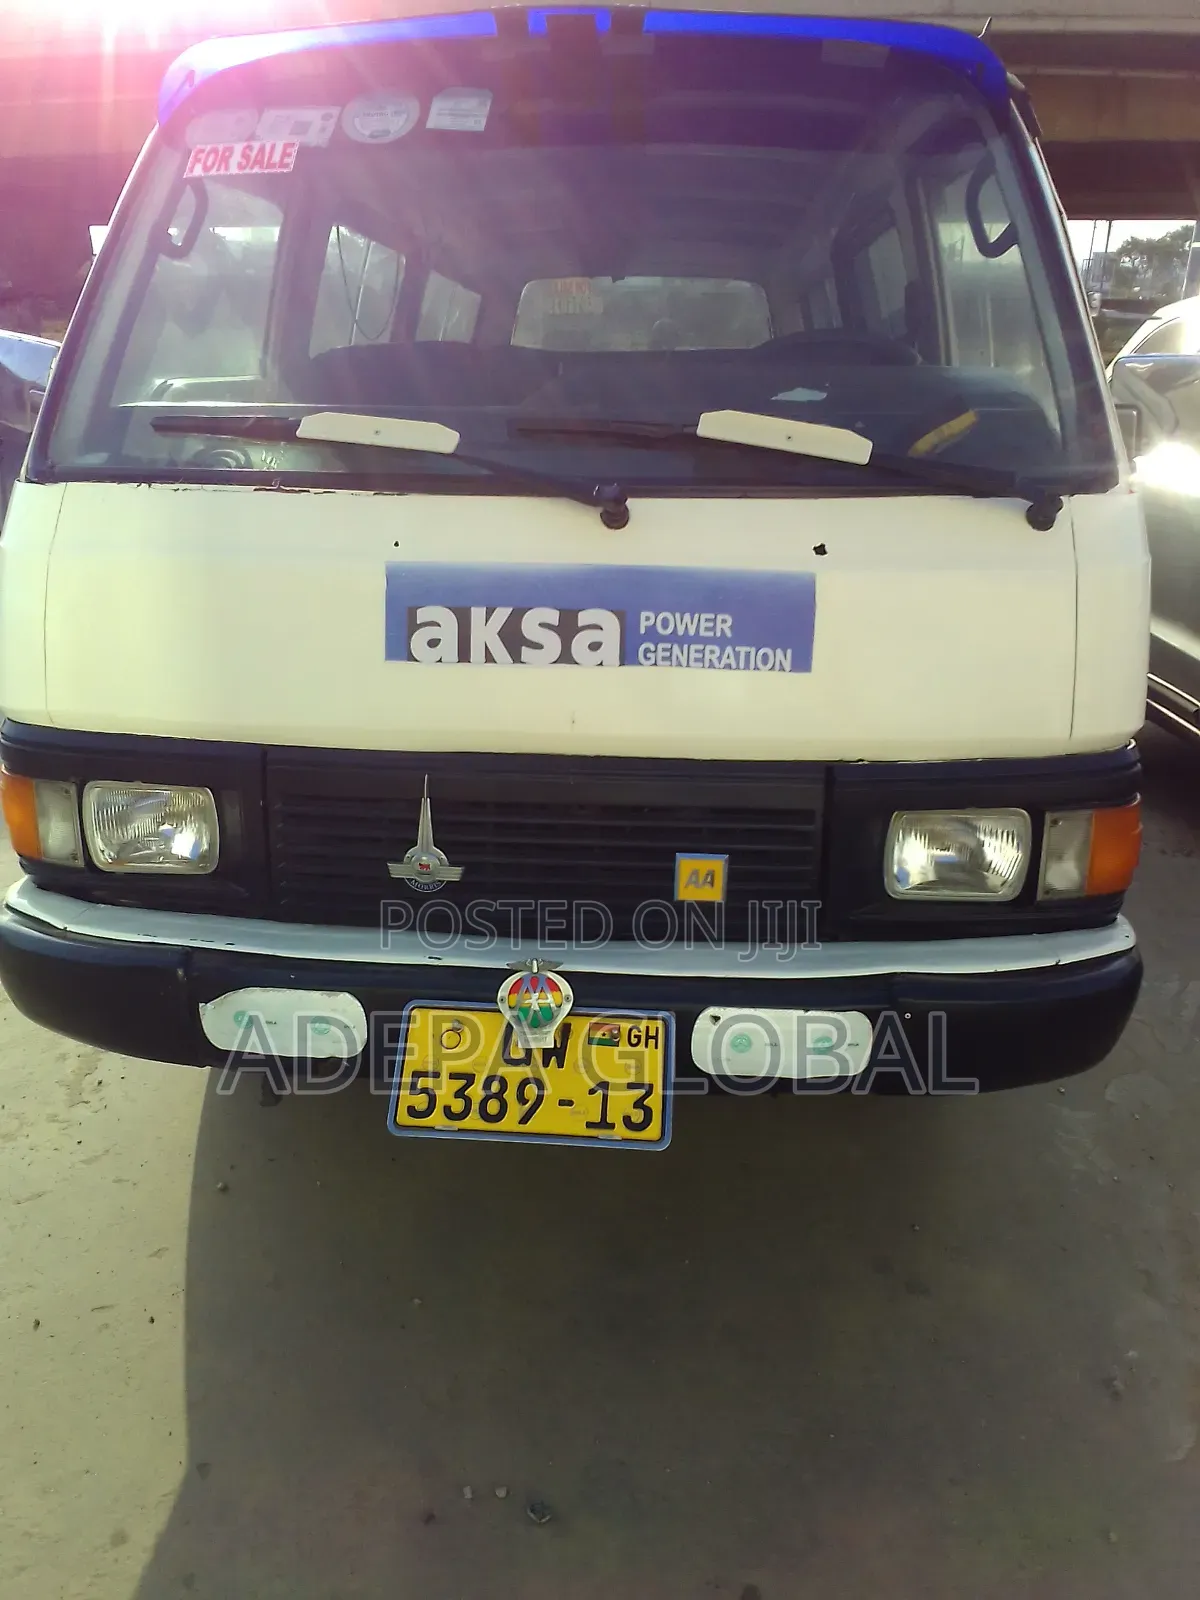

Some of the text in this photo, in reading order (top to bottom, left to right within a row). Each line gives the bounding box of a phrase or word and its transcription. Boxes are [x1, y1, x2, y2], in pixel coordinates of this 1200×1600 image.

[187, 141, 298, 173] FOR SALE
[410, 605, 621, 667] aksa
[639, 611, 732, 638] POWER
[638, 642, 792, 672] GENERATION
[411, 879, 442, 891] MORRIS
[684, 868, 715, 889] AA
[627, 1025, 660, 1050] GH
